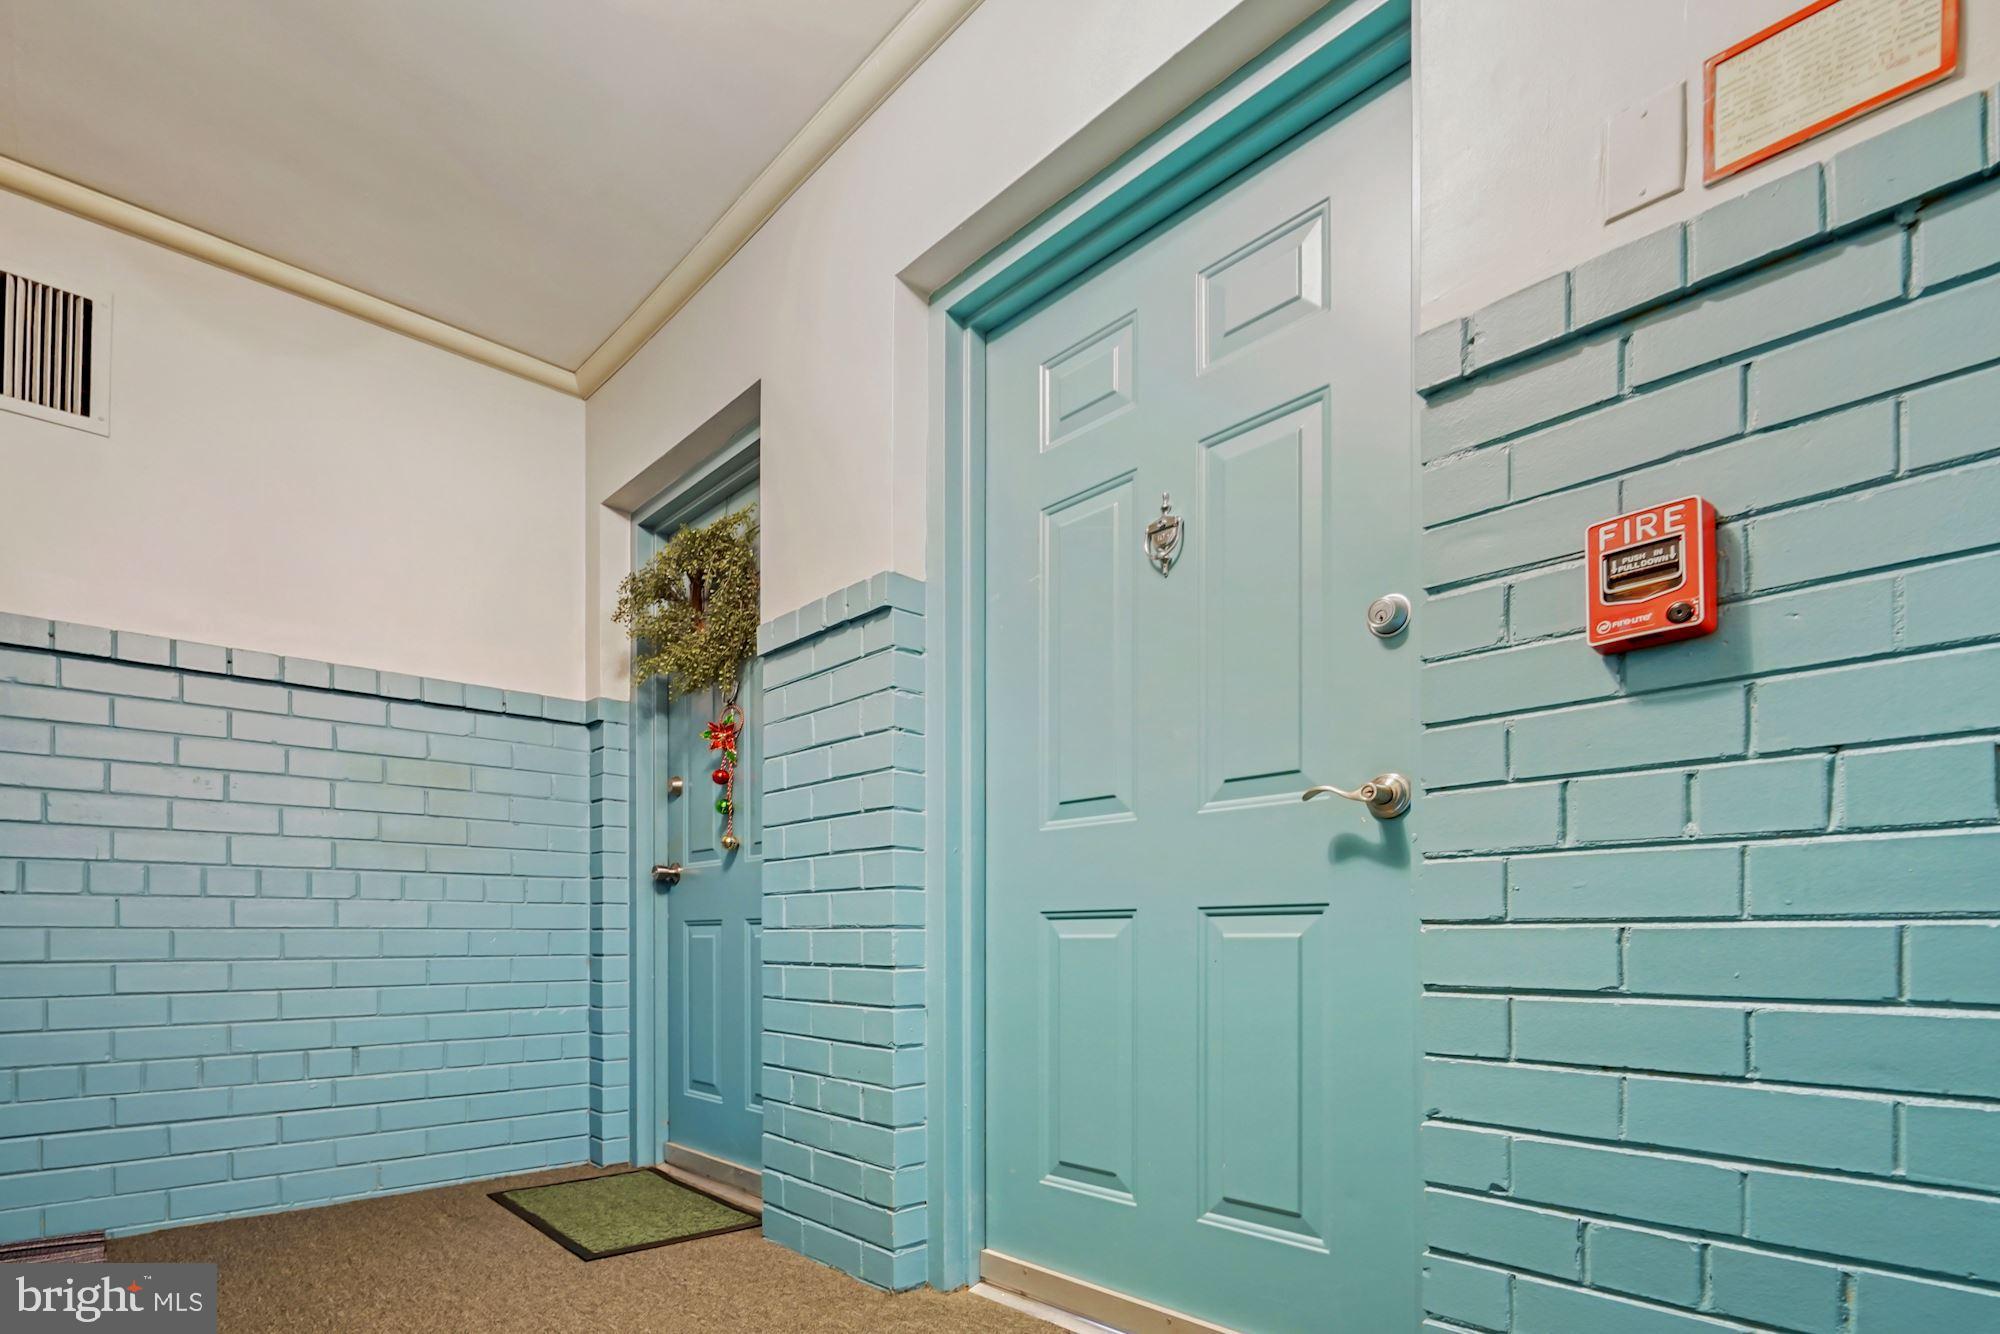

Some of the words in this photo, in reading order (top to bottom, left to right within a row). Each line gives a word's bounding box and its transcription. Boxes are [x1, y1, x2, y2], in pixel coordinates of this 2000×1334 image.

[1598, 504, 1686, 551] FIRE
[1617, 562, 1641, 574] PULL
[1641, 554, 1669, 567] DOWN
[1622, 552, 1647, 565] PUSH
[1653, 547, 1664, 556] IN
